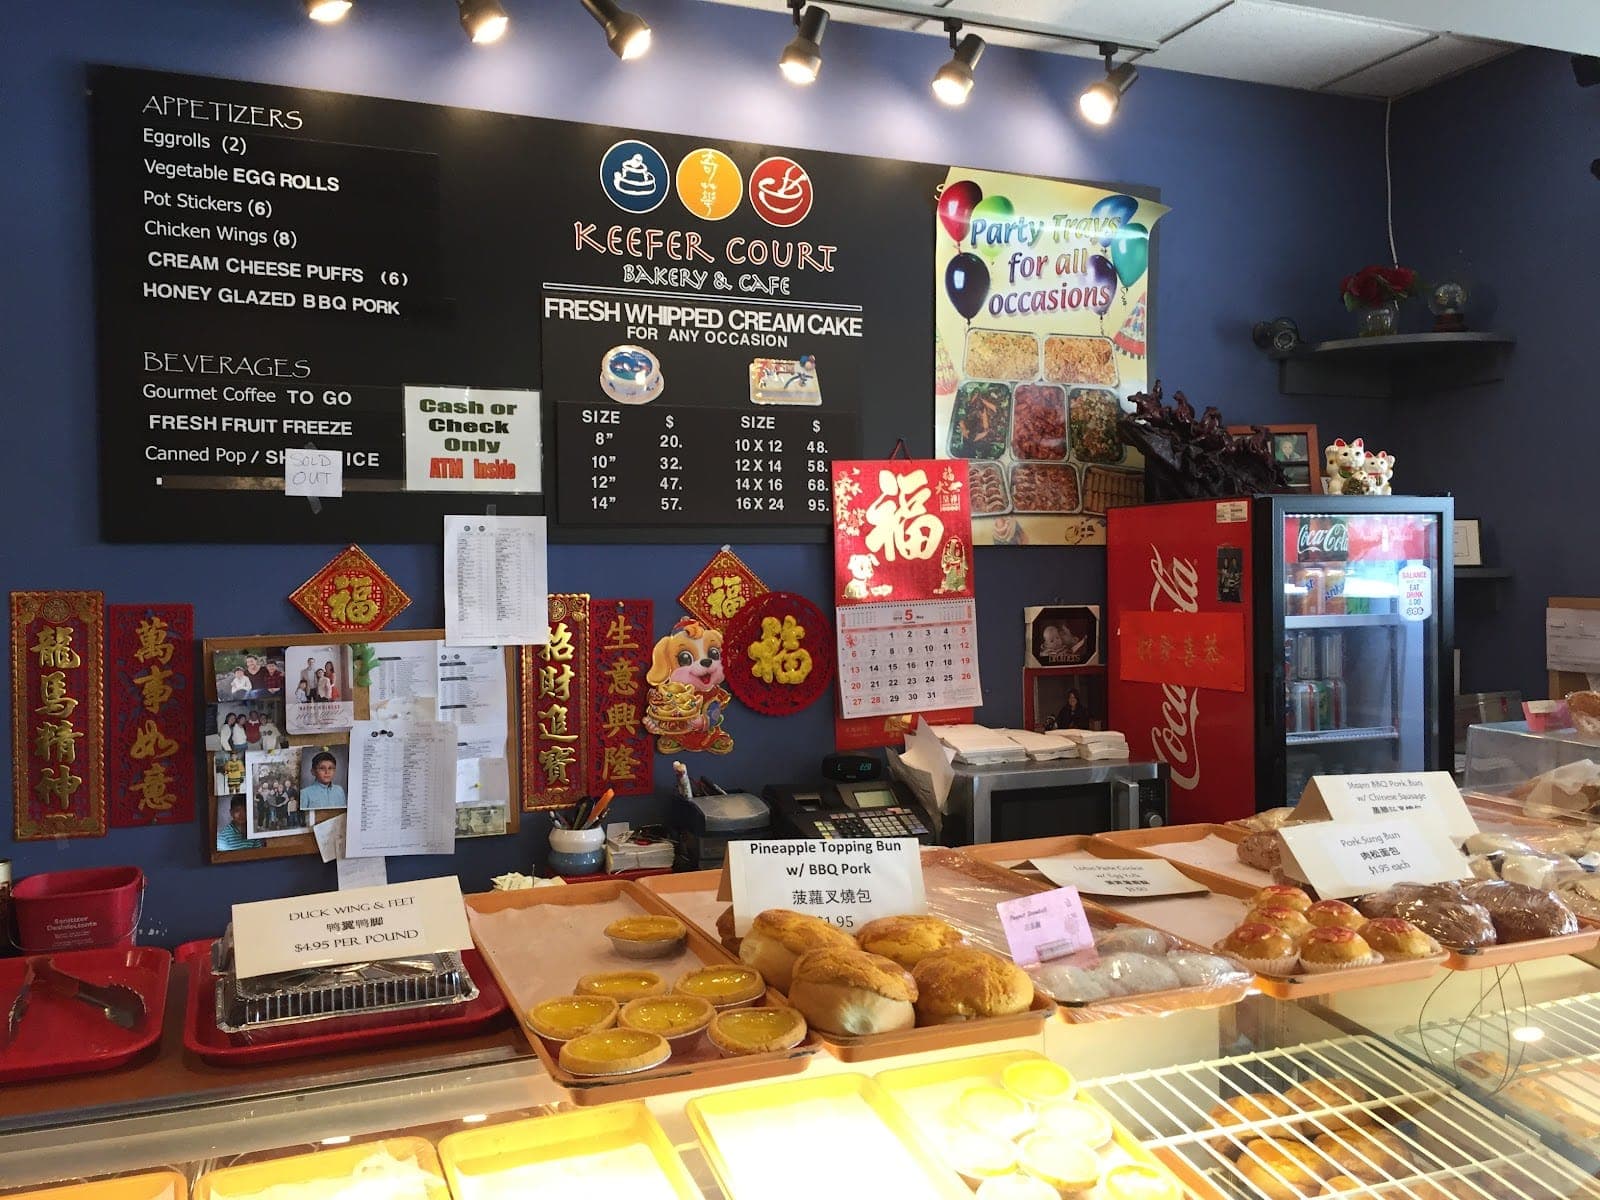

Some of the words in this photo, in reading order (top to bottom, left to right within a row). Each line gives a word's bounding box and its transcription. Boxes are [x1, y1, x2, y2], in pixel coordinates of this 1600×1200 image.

[142, 95, 303, 130] APPETIZERS
[143, 128, 210, 150] Eggrolls
[222, 136, 247, 155] (2)
[144, 159, 228, 182] Vegetable
[233, 168, 276, 187] EGG
[280, 172, 340, 192] ROLLS
[144, 190, 171, 208] Pot
[177, 194, 242, 213] Stickers
[248, 199, 272, 218] (6)
[145, 221, 210, 240] Chicken
[217, 226, 267, 246] Wings
[273, 230, 297, 249] (8)
[970, 218, 1043, 246] Party
[1052, 214, 1121, 245] Trays
[574, 221, 715, 264] KEEFER
[726, 237, 838, 273] COURT
[148, 252, 219, 271] CREAM
[226, 258, 301, 278] CHEESE
[307, 264, 363, 284] PUFFS
[381, 271, 408, 288] (6)
[1008, 252, 1048, 283] for
[1055, 248, 1088, 276] all
[623, 264, 708, 290] BAKERY
[713, 271, 732, 290] &
[738, 274, 790, 295] CAFE
[144, 283, 212, 302] HONEY
[218, 288, 296, 307] GLAZED
[352, 298, 399, 315] PORK
[988, 282, 1111, 316] occasions
[544, 298, 620, 322] FRESH
[625, 303, 721, 329] WHIPPED
[728, 310, 805, 334] CREAM
[808, 314, 863, 337] CAKE
[627, 326, 658, 341] FOR
[669, 329, 699, 343] ANY
[705, 331, 788, 348] OCCASION
[143, 351, 311, 379] BEVERAGES
[142, 384, 218, 401] Gourmet
[223, 386, 276, 403] Coffee
[287, 390, 314, 405] TO
[323, 391, 352, 406] GO
[419, 398, 486, 415] Cash
[490, 401, 518, 416] or
[149, 414, 217, 432] FRESH
[222, 417, 277, 434] FRUIT
[283, 420, 352, 436] FREEZE
[428, 418, 510, 435] Check
[582, 410, 620, 425] SIZE
[666, 415, 674, 429] $
[741, 415, 775, 430] SIZE
[813, 420, 821, 434] $
[444, 438, 501, 454] Only
[660, 435, 683, 449] 20.
[735, 439, 750, 453] 10
[753, 439, 764, 453] X
[768, 440, 783, 453] 12
[806, 441, 828, 455] 48.
[145, 445, 209, 464] Canned
[216, 448, 247, 466] Pop
[346, 452, 380, 467] ICE
[291, 453, 332, 468] SOLD
[660, 457, 683, 471] 32.
[735, 459, 750, 472] 12
[753, 459, 764, 472] X
[768, 460, 782, 473] 14
[807, 460, 828, 473] 58.
[292, 471, 331, 486] OUT
[429, 458, 464, 479] ATM
[474, 458, 516, 480] Inside
[660, 477, 683, 491] 47.
[735, 478, 750, 491] 14
[753, 478, 764, 491] X
[768, 479, 783, 492] 16
[808, 479, 829, 492] 68.
[661, 497, 682, 511] 57.
[736, 497, 751, 510] 16
[754, 497, 764, 511] X
[769, 498, 784, 511] 24
[808, 499, 830, 512] 95.
[865, 469, 944, 562] 福
[327, 575, 380, 624] 福
[706, 576, 746, 619] 福
[905, 609, 913, 621] 5
[748, 615, 812, 684] 福
[925, 660, 934, 668] 17
[850, 682, 861, 690] 20
[538, 623, 579, 785] 招財進寶
[602, 615, 641, 781] 生意興隆
[852, 698, 862, 706] 27
[908, 693, 918, 701] 30
[30, 626, 84, 810] 龍馬精神
[129, 616, 180, 811] 萬事如意
[750, 841, 816, 856] Pineapple
[819, 841, 873, 855] Topping
[877, 840, 901, 851] Bun
[1340, 837, 1361, 848] Pork
[1383, 832, 1401, 842] Bun
[786, 863, 805, 878] w/
[809, 864, 839, 877] BBQ
[842, 863, 871, 874] Pork
[1391, 860, 1411, 871] each
[792, 888, 872, 906] 菠蘿叉燒包
[289, 909, 329, 921] DUCK
[334, 903, 370, 915] WING
[373, 900, 384, 910] &
[387, 896, 416, 908] FEET
[294, 940, 330, 953] $4.95
[334, 936, 359, 949] PER
[365, 929, 419, 944] POUND
